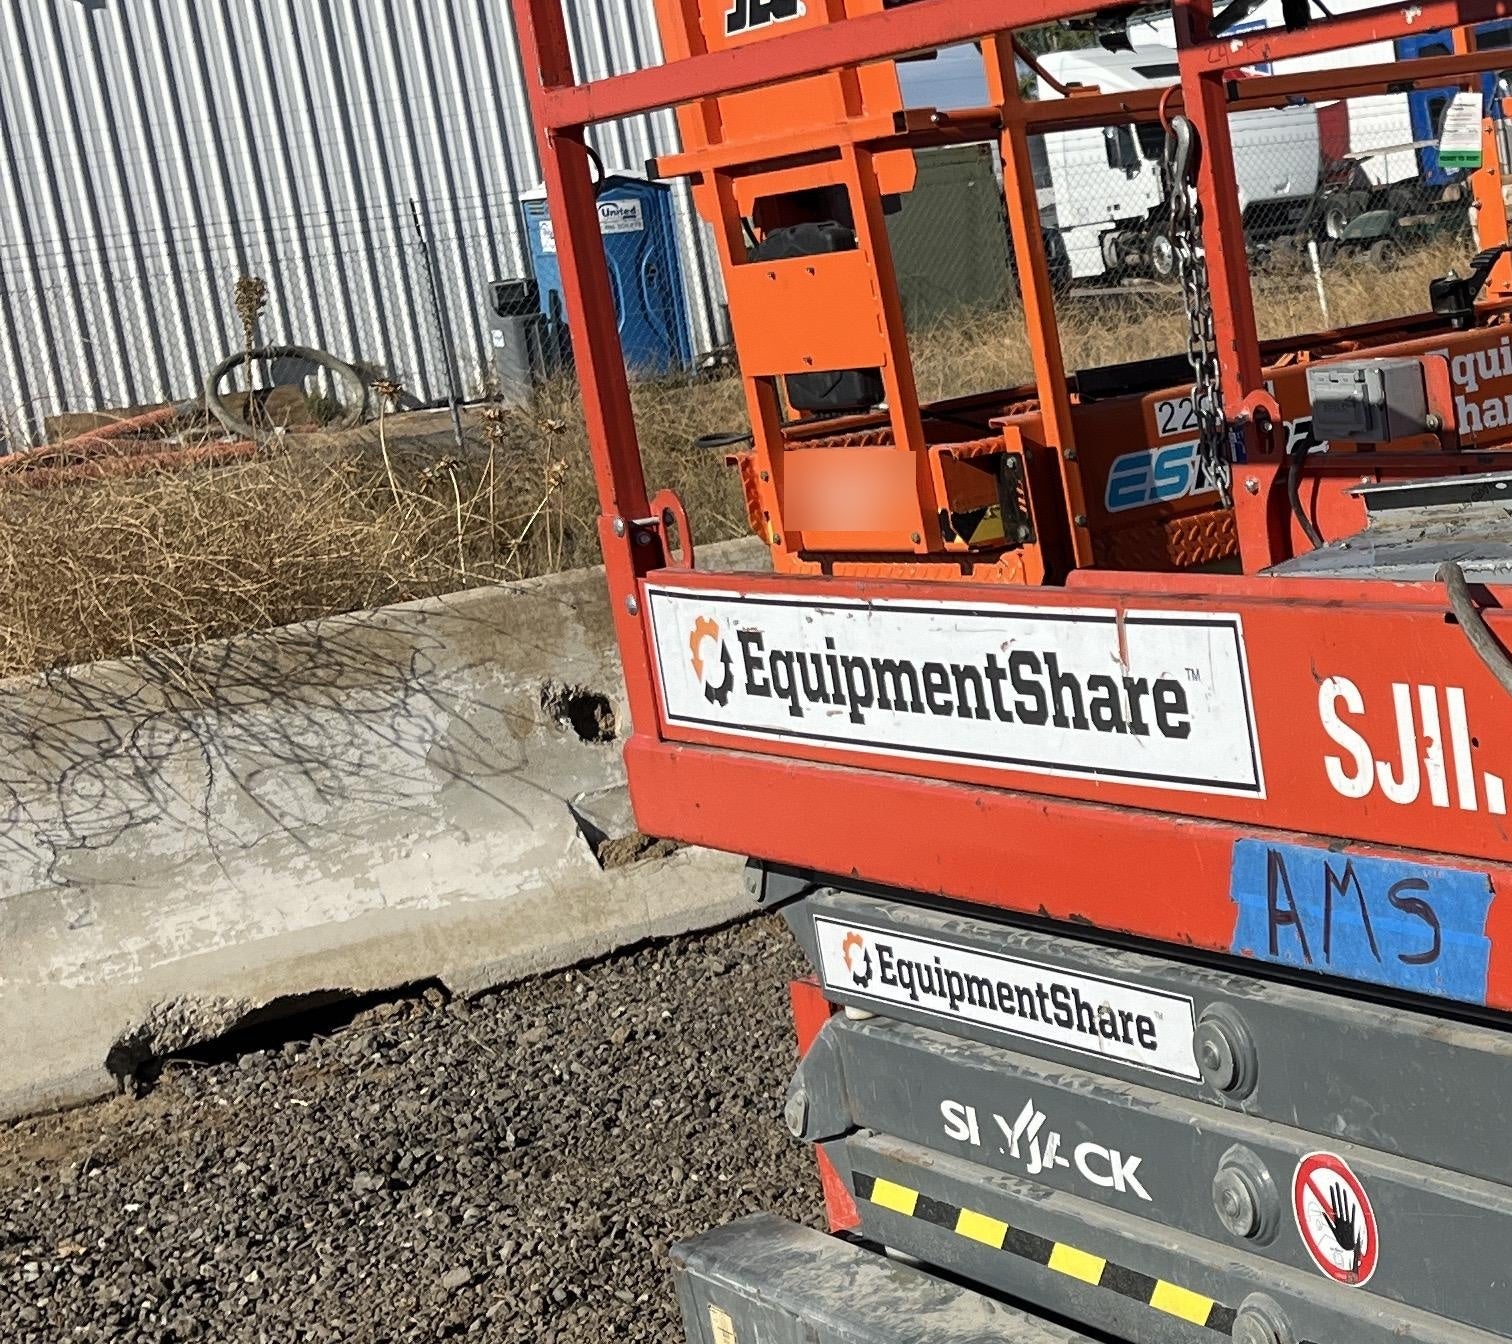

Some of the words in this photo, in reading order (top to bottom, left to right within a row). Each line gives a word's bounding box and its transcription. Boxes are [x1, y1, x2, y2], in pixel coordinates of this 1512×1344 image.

[736, 629, 1192, 739] EquipmentShare
[1266, 847, 1442, 965] AMS
[874, 942, 1158, 1051] EquipmentShare
